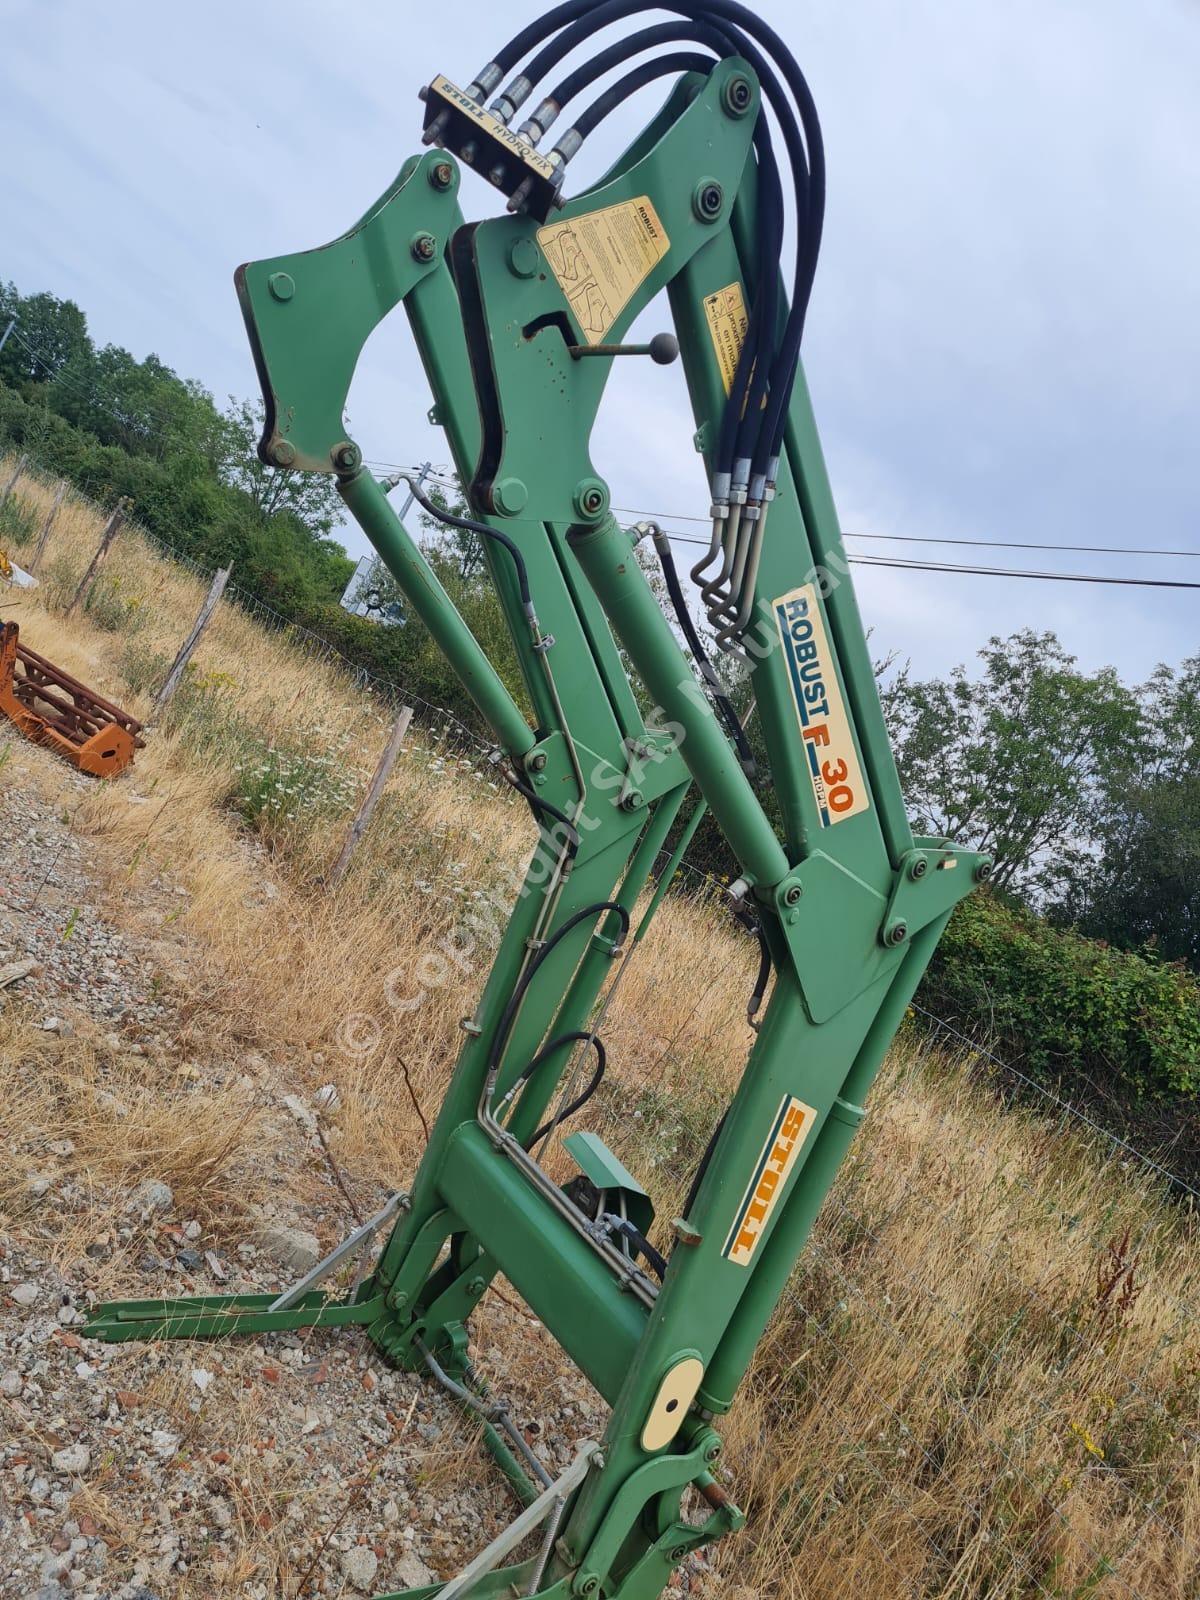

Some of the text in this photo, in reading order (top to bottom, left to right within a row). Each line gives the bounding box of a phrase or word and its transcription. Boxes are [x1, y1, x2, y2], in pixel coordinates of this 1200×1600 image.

[441, 83, 486, 121] STOLL
[638, 206, 658, 239] ROBUST
[787, 597, 853, 813] ROBUST F 30
[812, 775, 827, 808] HDPM
[732, 1106, 805, 1254] STOLL
